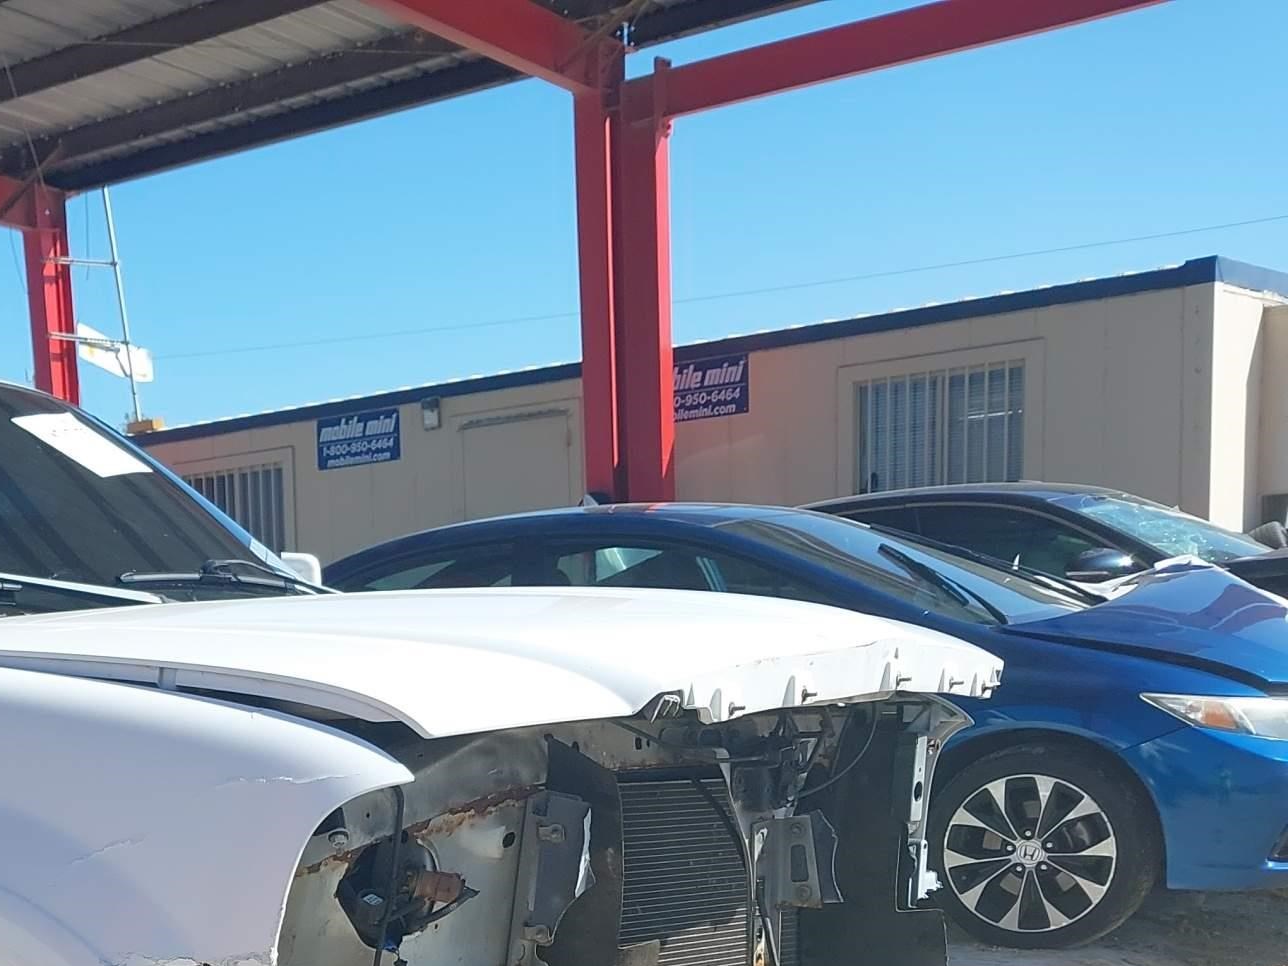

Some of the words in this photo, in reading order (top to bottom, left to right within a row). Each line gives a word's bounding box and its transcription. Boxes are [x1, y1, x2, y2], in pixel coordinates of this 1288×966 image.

[704, 361, 744, 386] mini
[674, 387, 741, 407] 0-950-6464
[320, 416, 364, 442] mobile
[365, 413, 397, 435] mini
[323, 438, 394, 456] 1-800-950-6464
